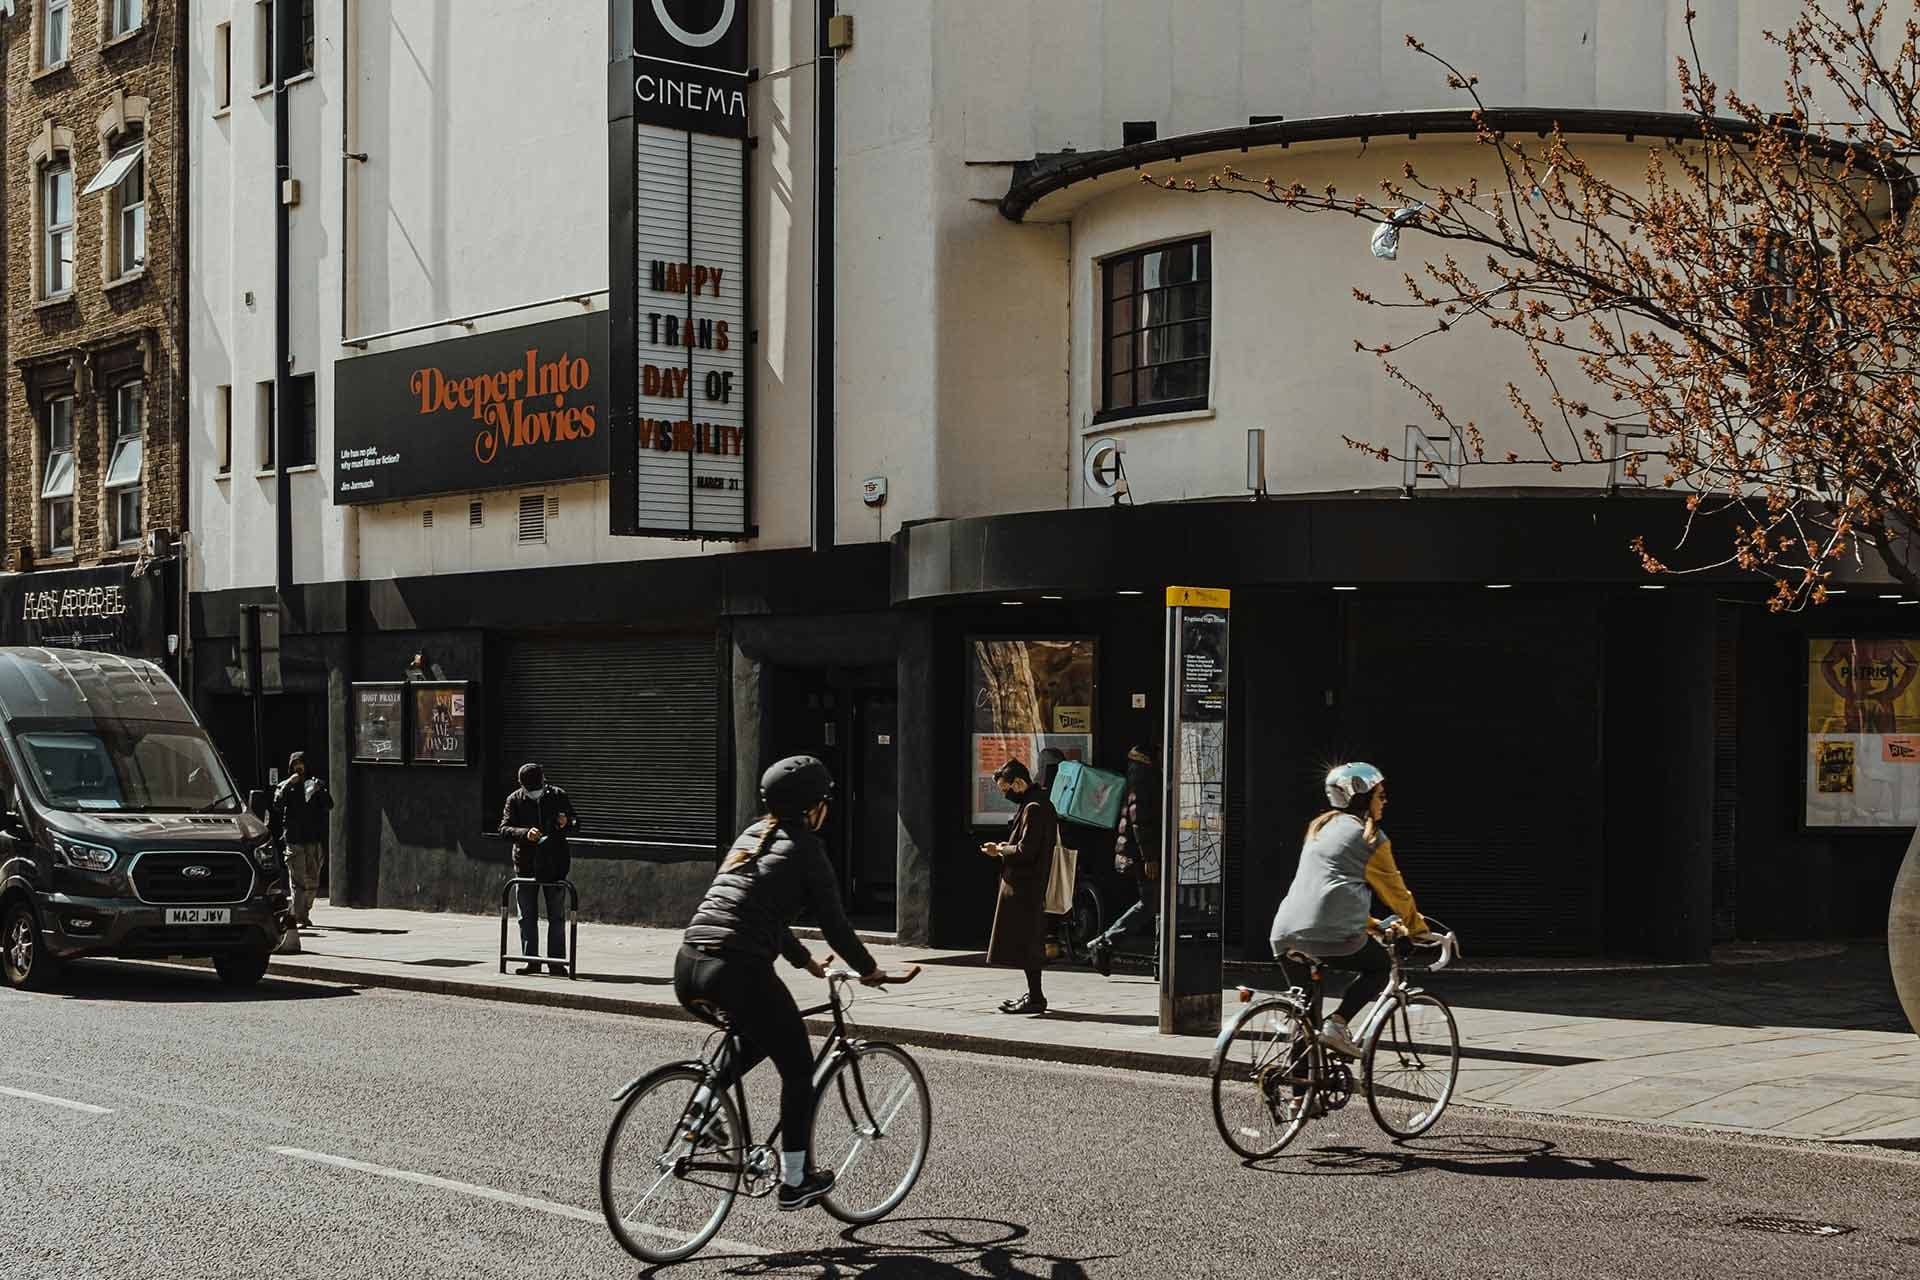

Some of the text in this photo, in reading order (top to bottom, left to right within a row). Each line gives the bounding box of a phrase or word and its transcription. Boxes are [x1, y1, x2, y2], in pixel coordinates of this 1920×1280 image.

[635, 74, 746, 117] CINEMA
[651, 260, 723, 297] HAPPY
[648, 312, 729, 351] TRANS
[410, 348, 590, 419] Deeper Into
[643, 364, 734, 404] DAY OF
[475, 394, 596, 464] Movies
[639, 417, 744, 457] VISIBILITY
[729, 478, 739, 490] 31
